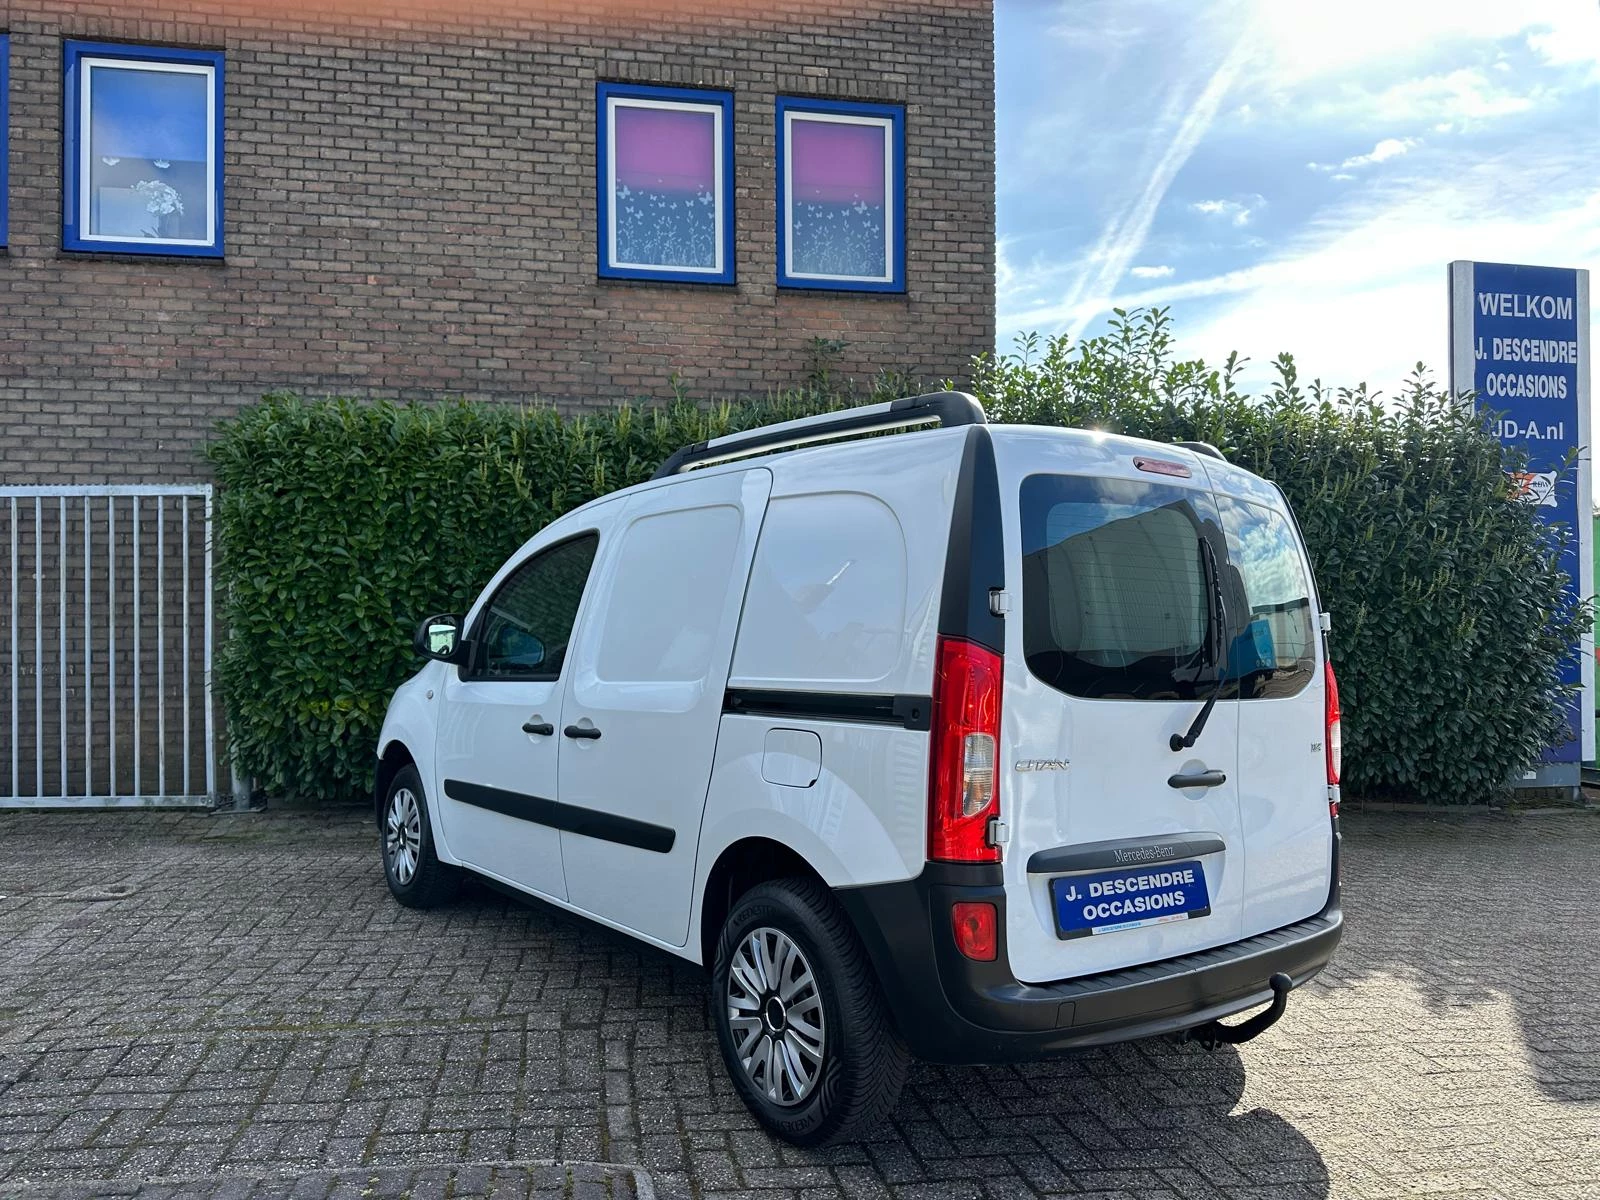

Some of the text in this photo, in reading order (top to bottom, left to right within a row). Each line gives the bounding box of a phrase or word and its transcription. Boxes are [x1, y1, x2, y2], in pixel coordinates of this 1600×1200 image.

[1478, 292, 1573, 320] WELKOM
[1474, 337, 1577, 364] J. DESCENDRE
[1486, 372, 1567, 399] OCCASIONS
[1491, 419, 1564, 440] JD-A.nl
[1113, 845, 1175, 864] Mercedes-Benz
[1065, 869, 1195, 902] J. DESCENDRE
[1083, 890, 1186, 921] OCCASIONS
